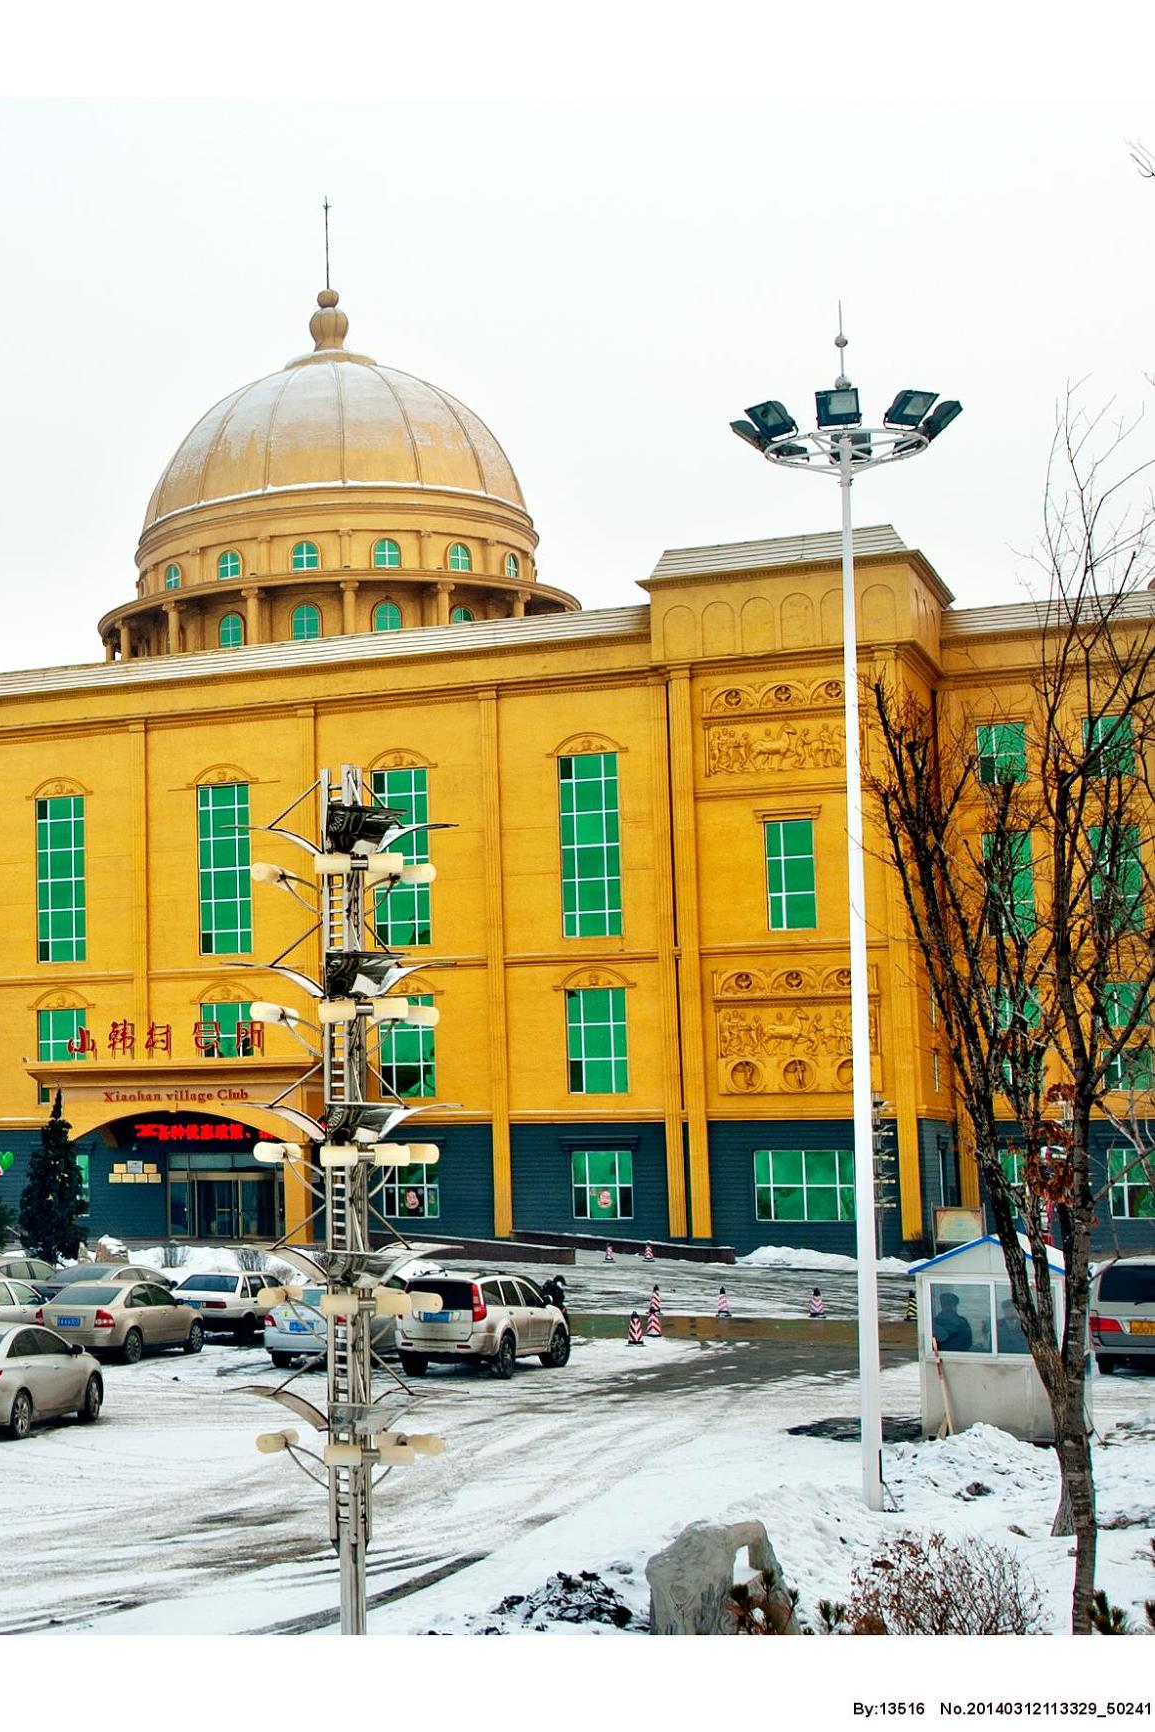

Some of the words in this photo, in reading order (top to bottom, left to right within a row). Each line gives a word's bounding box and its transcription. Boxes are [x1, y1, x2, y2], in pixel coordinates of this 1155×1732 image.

[103, 1090, 162, 1104] Xiaohan
[166, 1089, 214, 1104] village
[217, 1088, 249, 1101] Club
